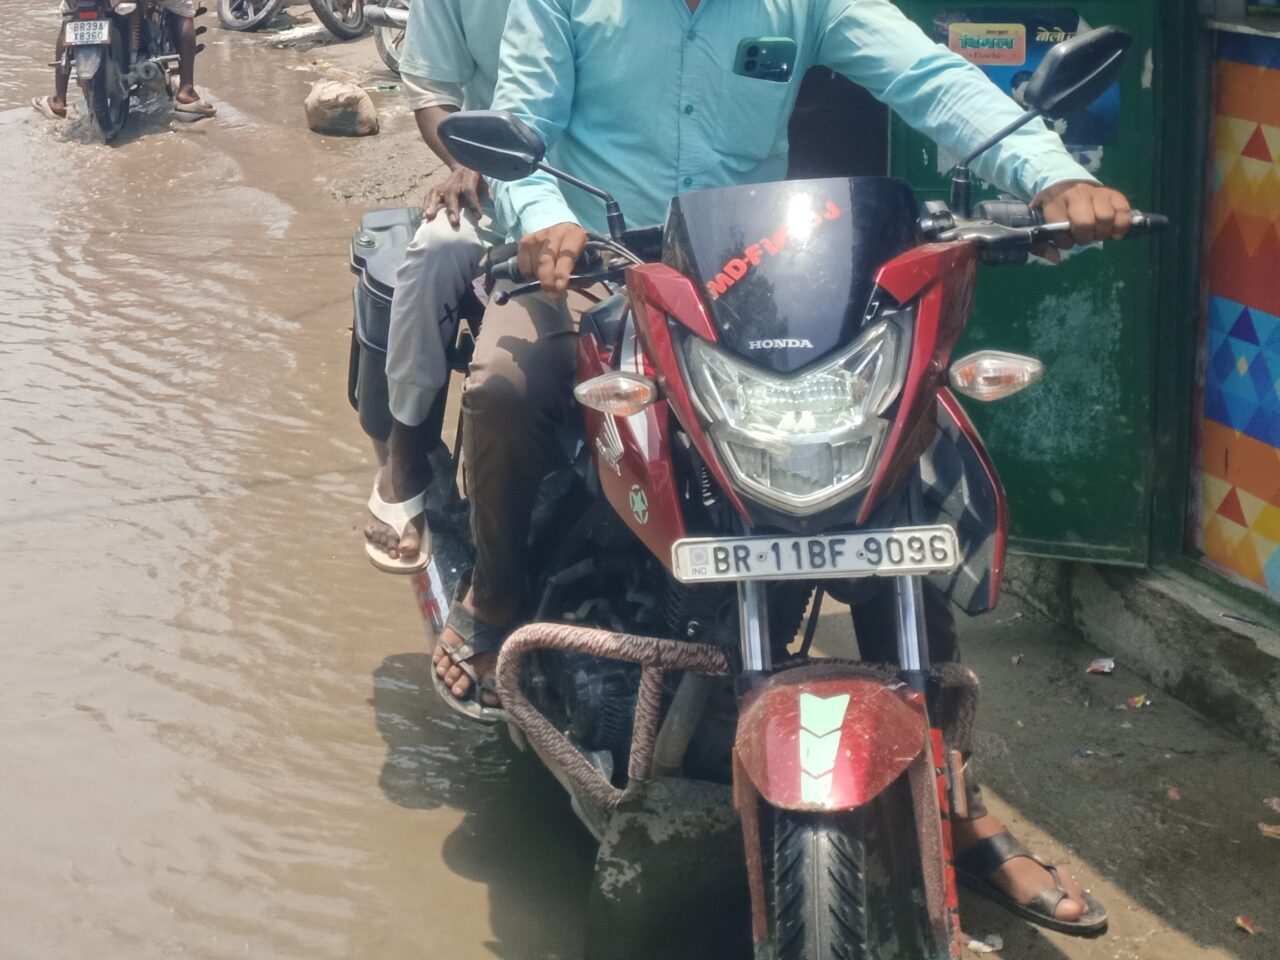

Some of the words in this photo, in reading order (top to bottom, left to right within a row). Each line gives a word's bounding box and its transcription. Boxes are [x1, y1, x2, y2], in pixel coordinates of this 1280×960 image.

[73, 22, 103, 31] BR39A
[749, 338, 814, 349] HONDA
[712, 544, 751, 574] BR
[771, 538, 847, 572] 11BF
[863, 534, 949, 566] 9096
[691, 566, 708, 576] IND
